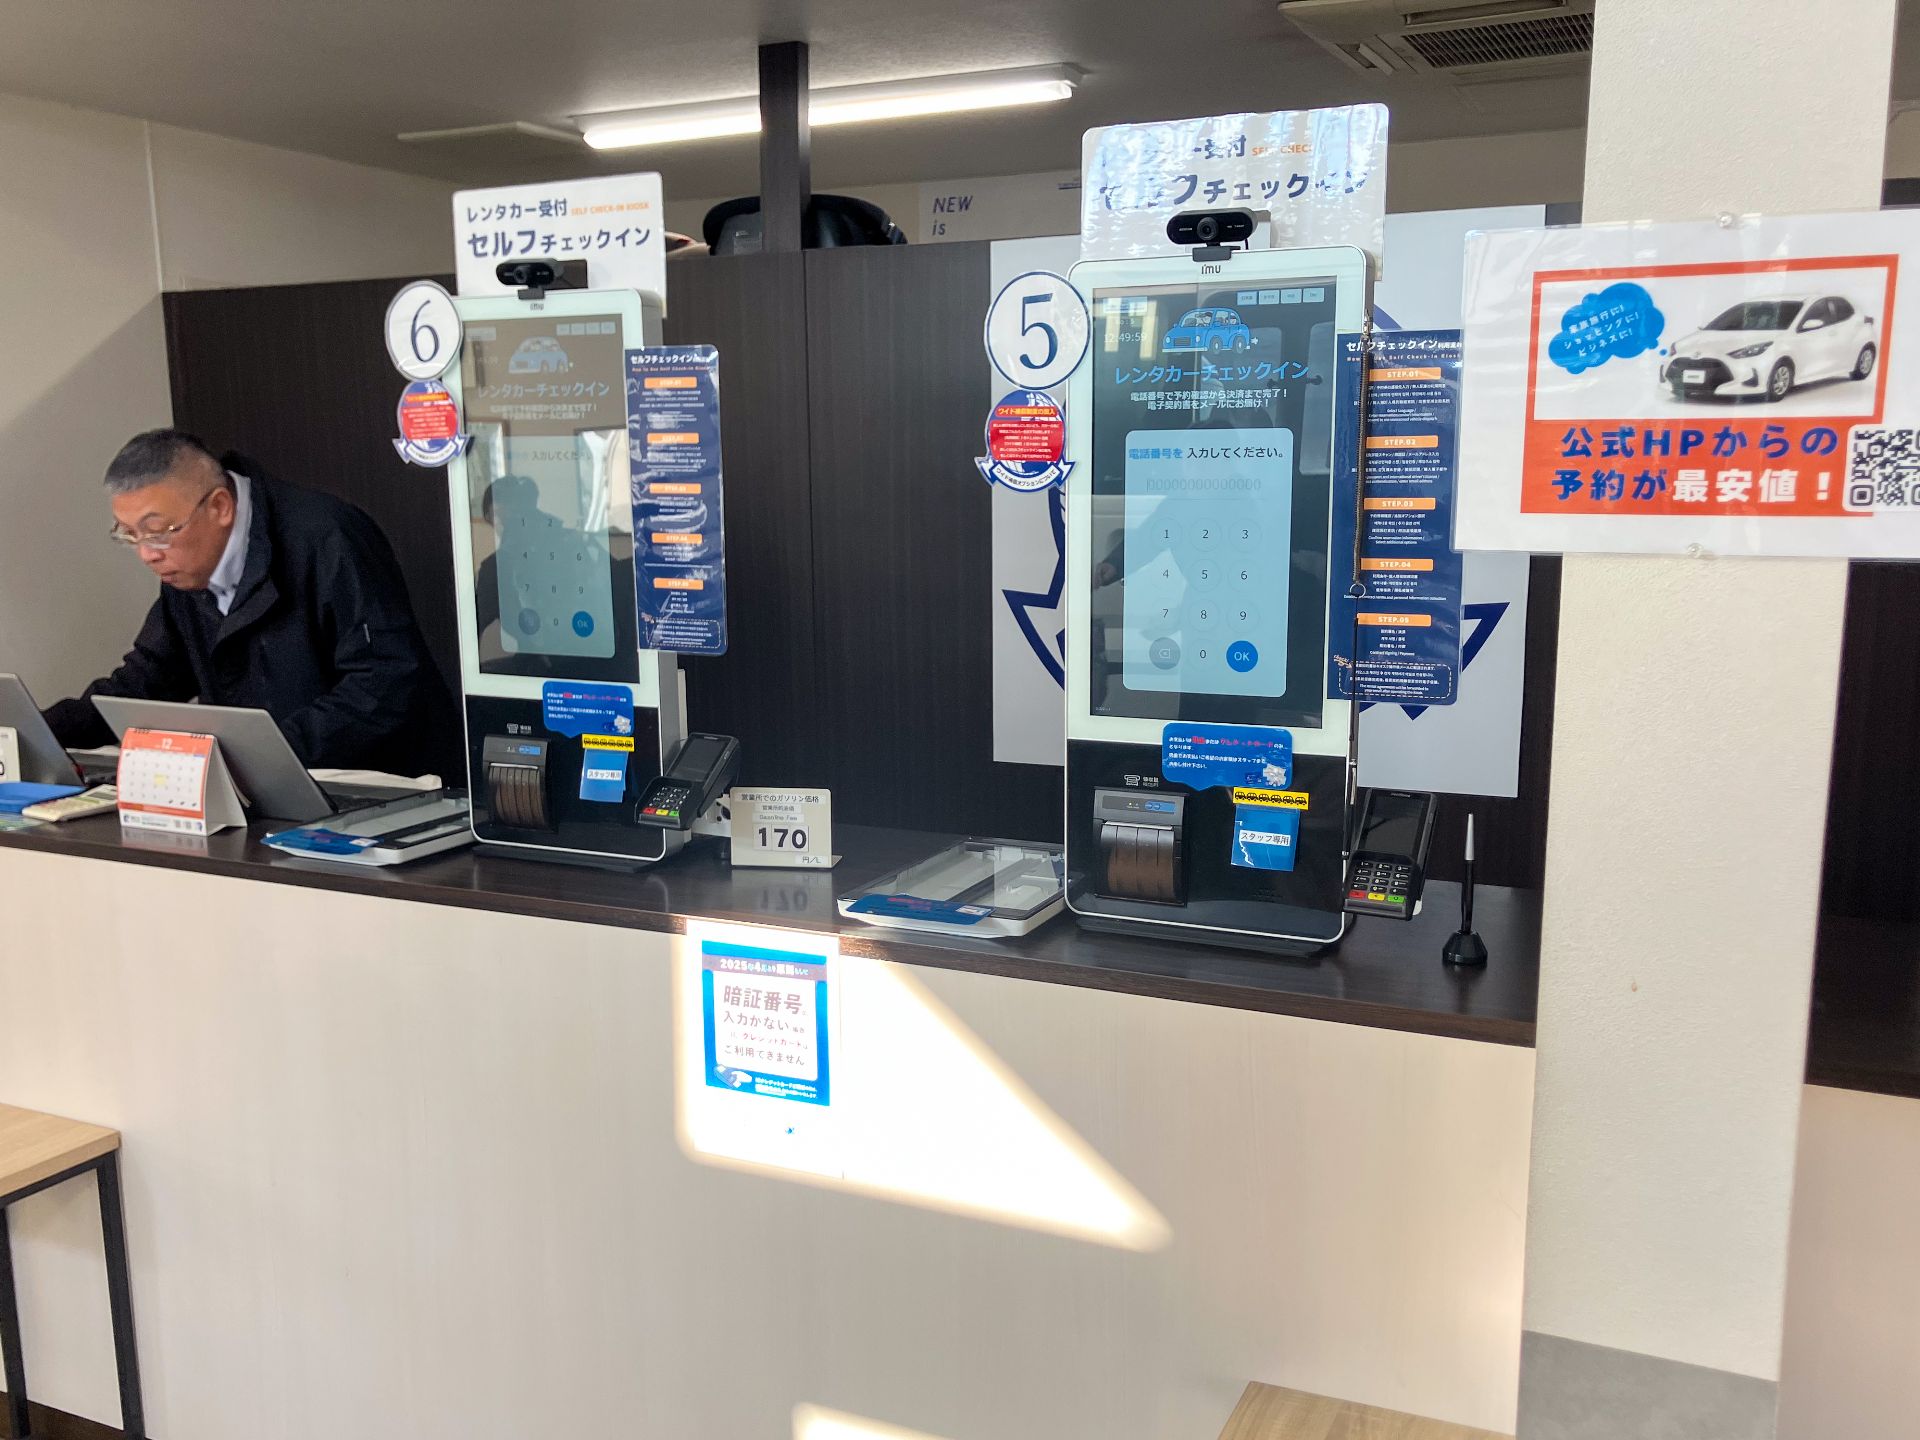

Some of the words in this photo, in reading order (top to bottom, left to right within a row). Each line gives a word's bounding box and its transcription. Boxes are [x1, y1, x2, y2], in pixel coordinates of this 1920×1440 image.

[467, 198, 567, 223] レンタカー受付
[932, 195, 974, 214] NEW
[931, 219, 946, 236] is
[467, 227, 651, 258] セルフチェックイン
[410, 300, 439, 363] 6
[1019, 293, 1059, 370] 5
[1114, 361, 1309, 385] レンタカーチェックイン
[477, 381, 610, 399] レンタカーチェックイン
[1560, 426, 1838, 460] 公式HPからの
[1551, 468, 1830, 504] 予約が最安値！
[1163, 529, 1169, 539] 1
[1202, 529, 1209, 539] 2
[1242, 529, 1249, 539] 3
[1163, 569, 1170, 579] 4
[1201, 569, 1208, 580] 5
[1240, 570, 1248, 580] 6
[1162, 609, 1169, 619] 7
[1200, 609, 1207, 620] 8
[1239, 610, 1247, 621] 9
[1199, 649, 1207, 660] 0
[1233, 651, 1250, 662] OK
[741, 793, 820, 804] 営業所でのガソリン価格
[758, 827, 807, 850] 170
[1240, 832, 1290, 846] スタッフ専用
